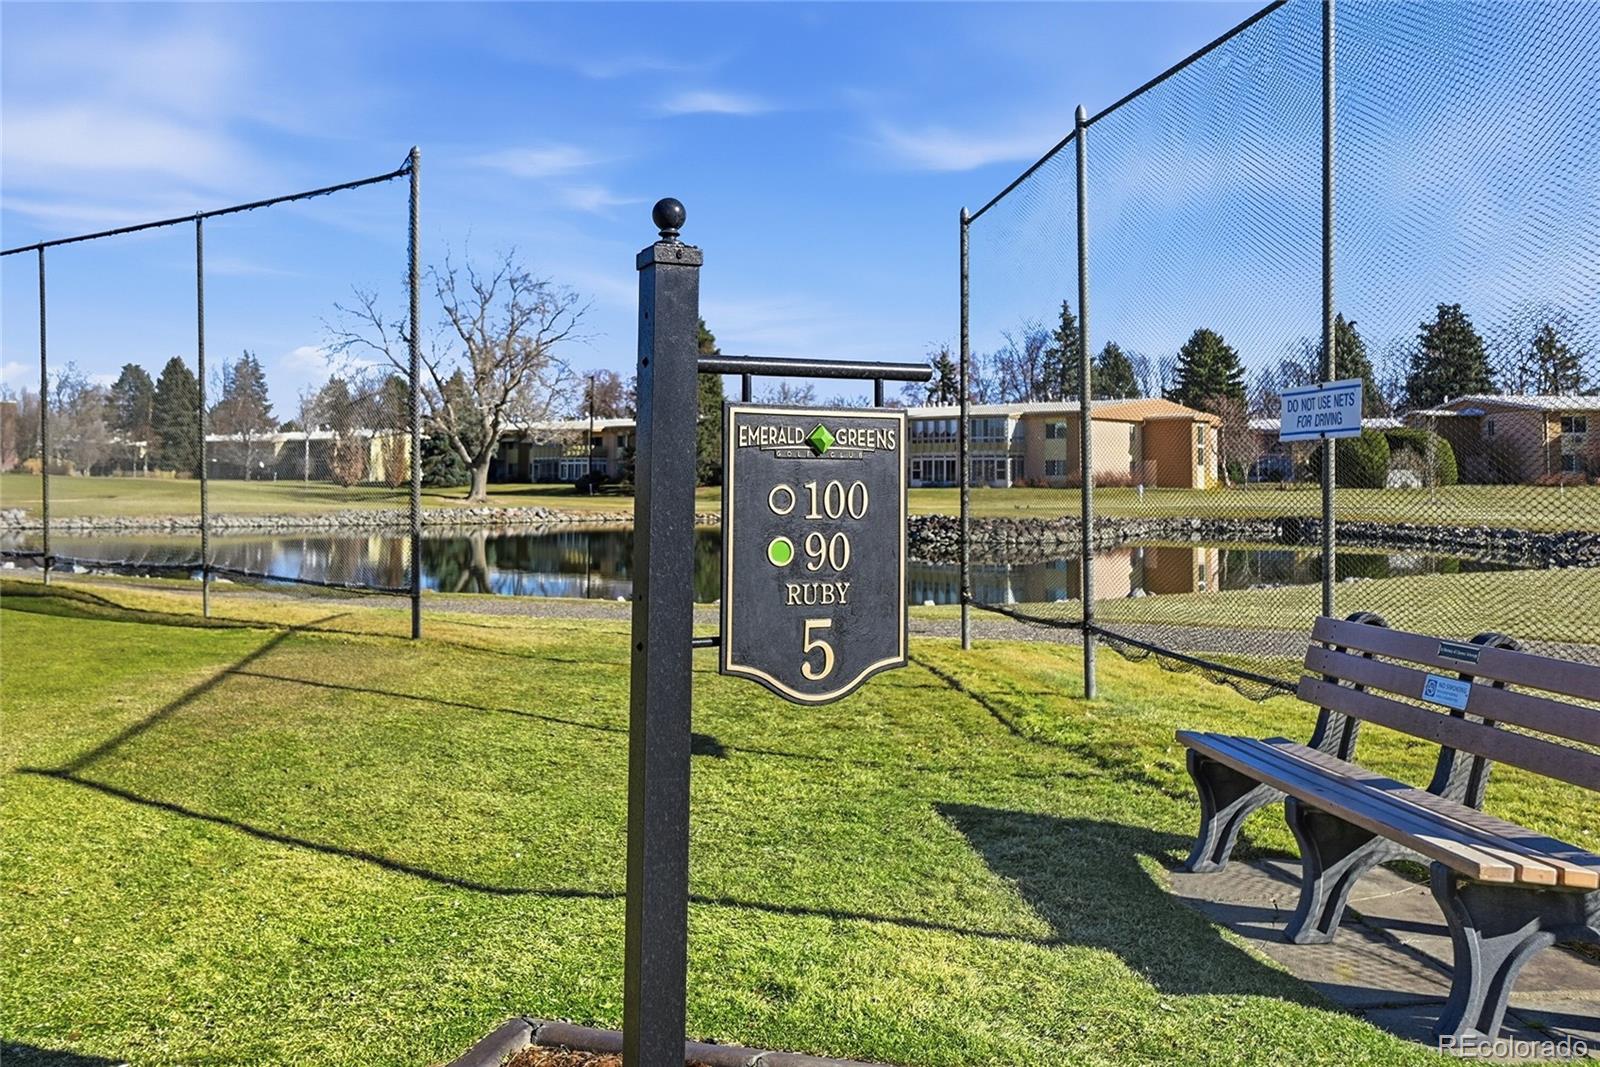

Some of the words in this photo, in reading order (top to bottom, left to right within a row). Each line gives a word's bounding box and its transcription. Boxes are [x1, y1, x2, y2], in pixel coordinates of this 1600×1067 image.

[1288, 400, 1299, 413] DO
[1301, 397, 1316, 412] NOT
[1317, 395, 1331, 410] USE
[1334, 392, 1355, 407] NETS
[1297, 414, 1312, 428] FOR
[1315, 412, 1343, 427] DRIVING
[739, 425, 805, 447] EMERALD
[835, 428, 896, 450] GREENS
[803, 480, 869, 520] 100
[804, 532, 850, 572] 90
[785, 582, 851, 605] RUBY
[801, 619, 835, 681] 5
